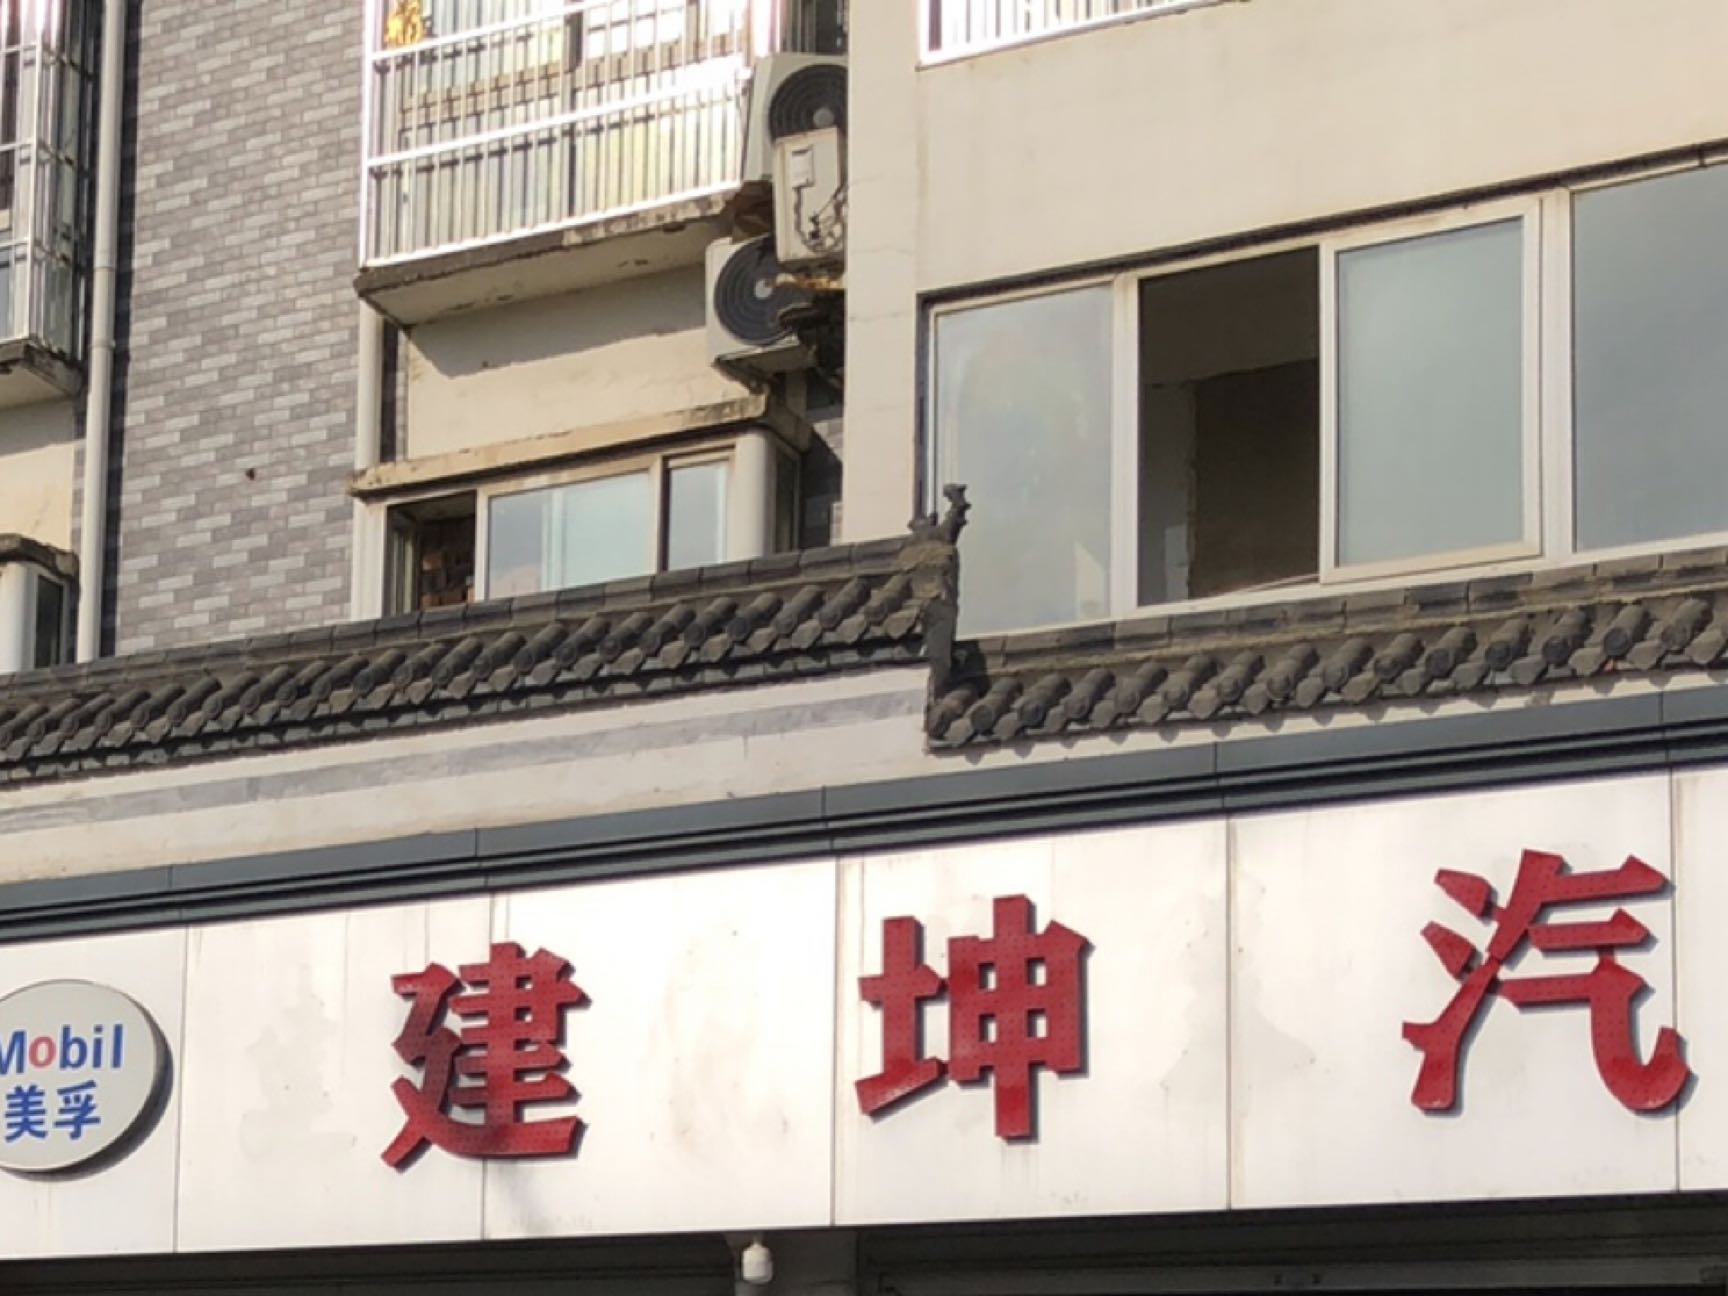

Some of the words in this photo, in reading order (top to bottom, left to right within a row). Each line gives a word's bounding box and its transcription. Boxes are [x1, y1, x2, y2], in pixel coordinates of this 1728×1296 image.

[379, 849, 1694, 1169] 建坤汽
[4, 1079, 102, 1143] 美孚
